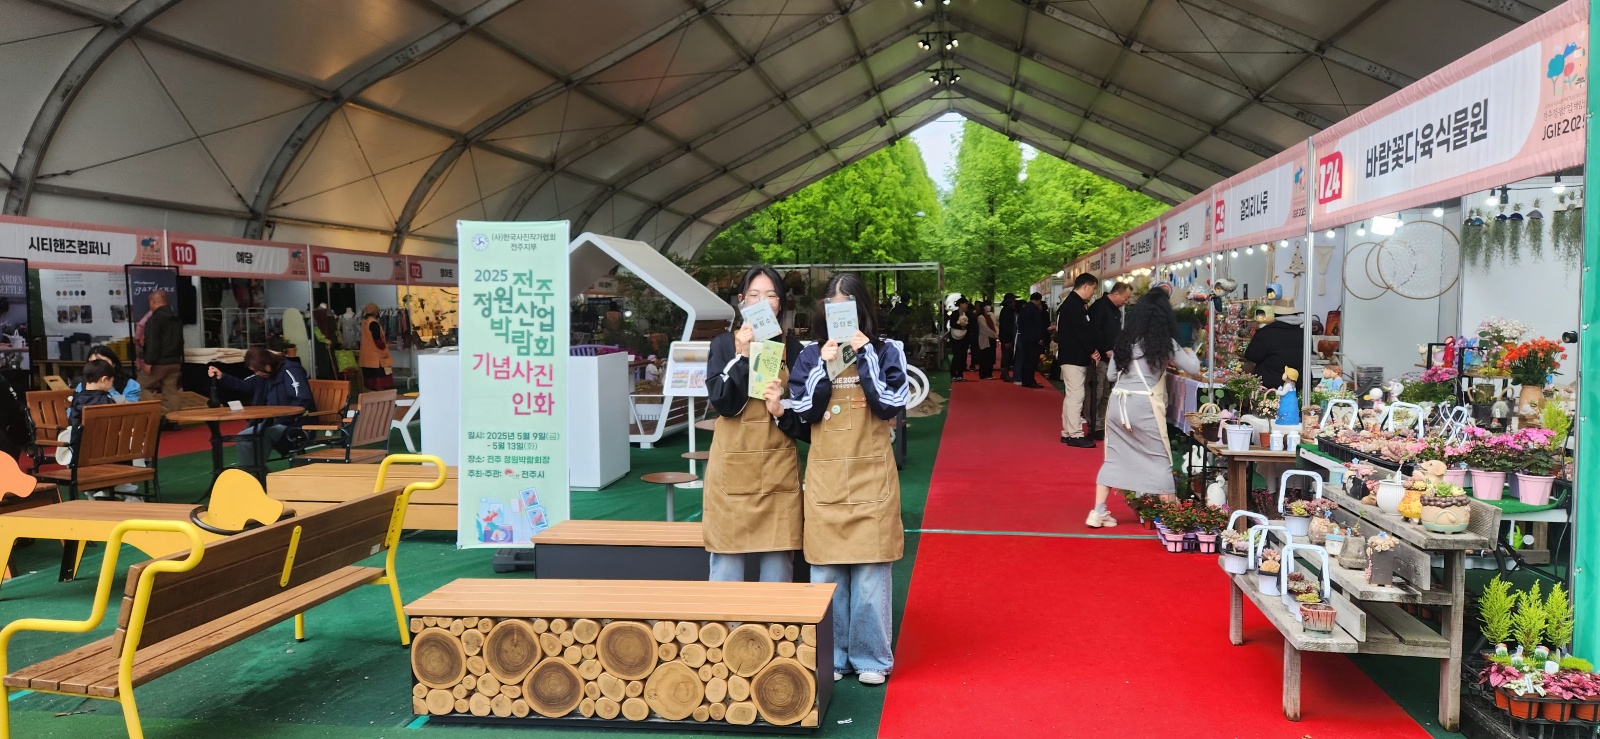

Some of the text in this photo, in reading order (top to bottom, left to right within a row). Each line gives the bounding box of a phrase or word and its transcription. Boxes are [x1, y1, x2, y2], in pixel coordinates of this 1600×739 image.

[1366, 98, 1488, 178] 바람꽃다육식물원
[1320, 157, 1341, 200] 124
[492, 233, 556, 242] (사)한국사진작가협회
[28, 237, 111, 256] 시티핸즈컴퍼니
[175, 246, 192, 262] 110
[510, 243, 537, 251] 전주지부
[236, 251, 253, 264] 예당
[316, 258, 326, 271] 111
[474, 269, 554, 304] 2025 전주
[473, 286, 554, 332] 정원산업
[490, 316, 554, 356] 박람회
[473, 352, 553, 387] 기념사진
[512, 392, 555, 416] 인화
[486, 432, 514, 440] 2025년
[517, 432, 530, 440] 5월
[532, 432, 560, 440] 9일(금)
[492, 442, 505, 450] 5월
[508, 442, 538, 450] 13일(화)
[504, 456, 550, 464] 정원박람회장
[522, 470, 545, 478] 전주시
